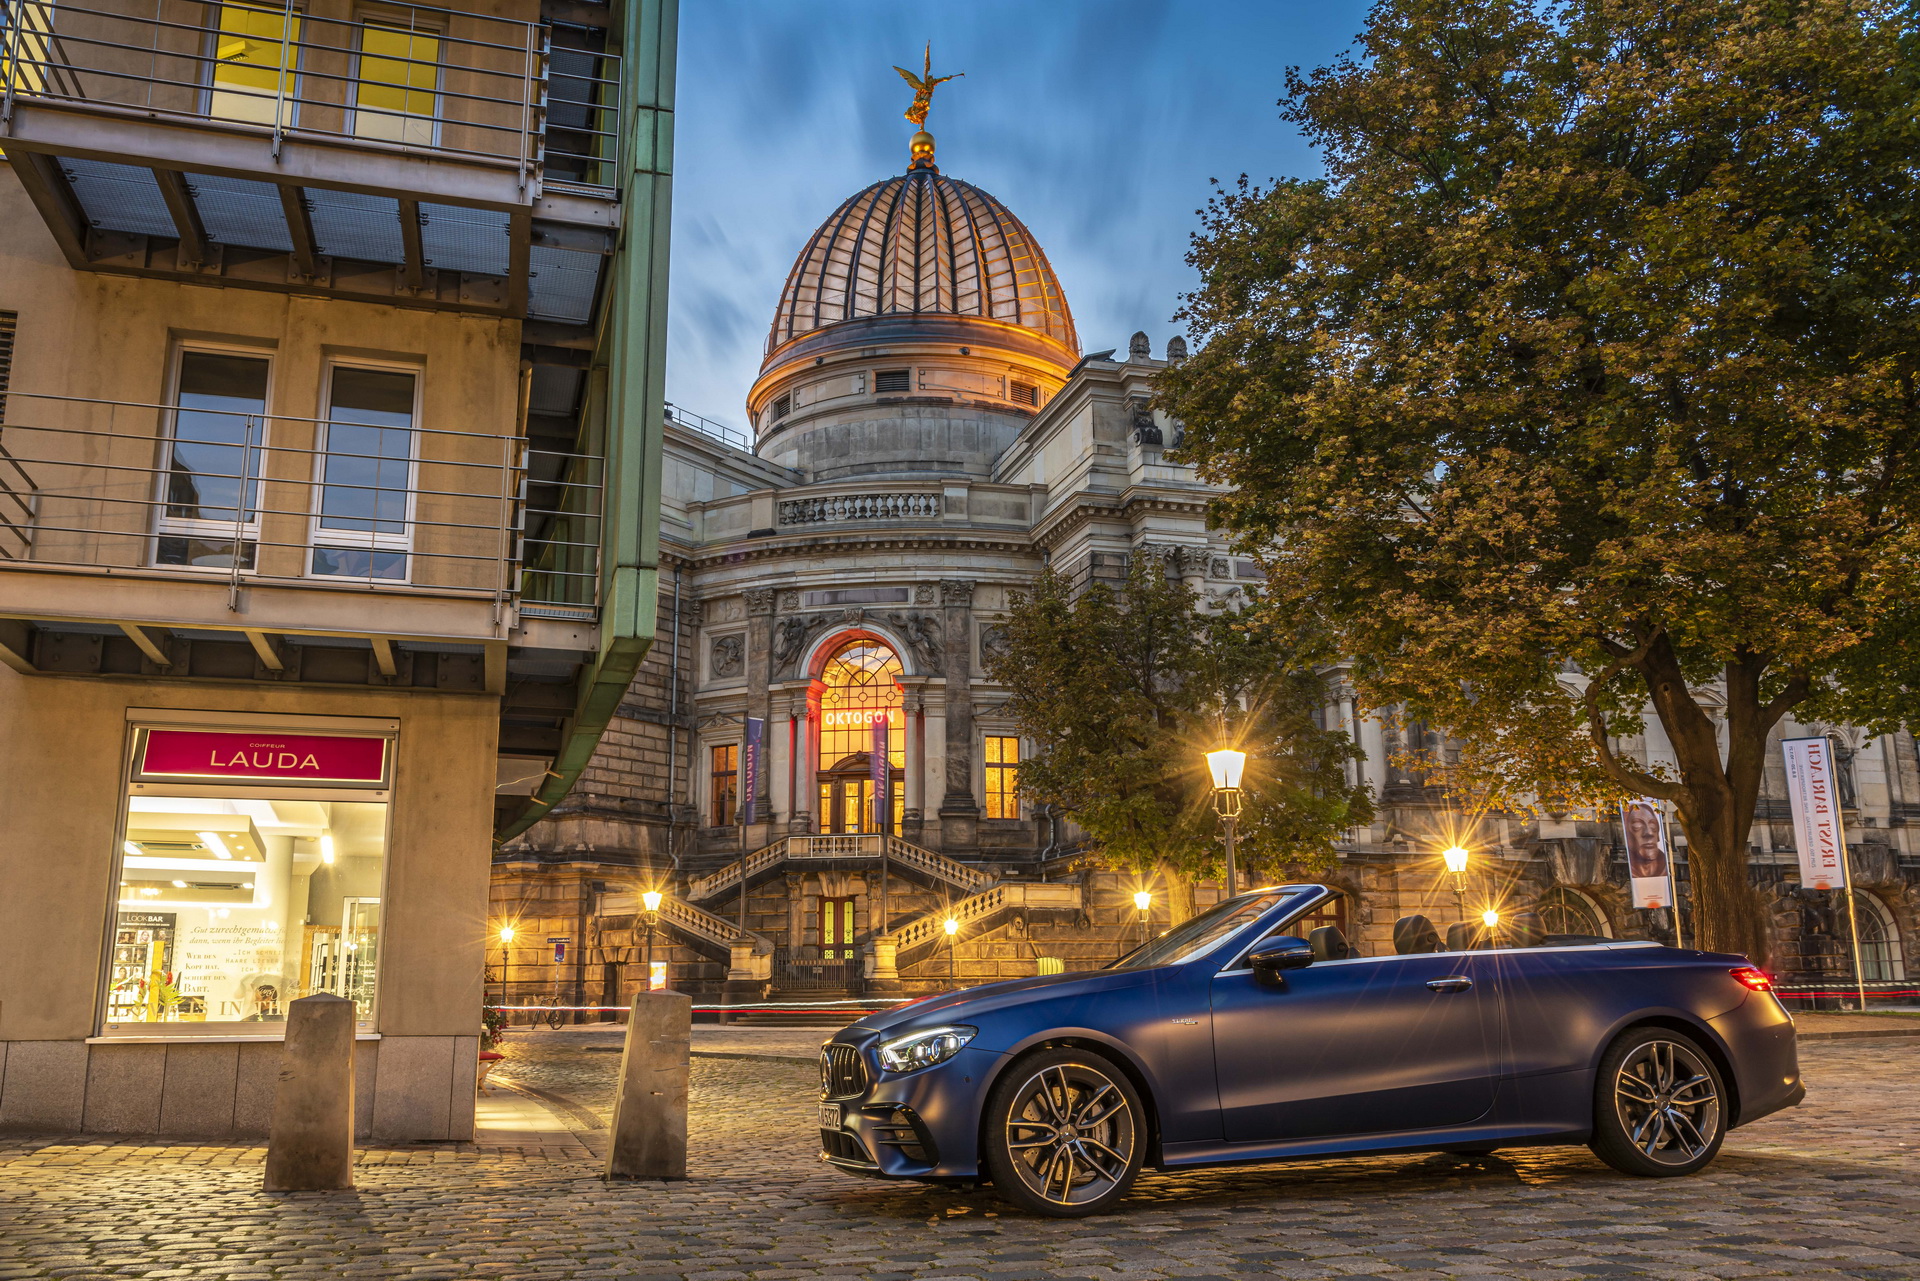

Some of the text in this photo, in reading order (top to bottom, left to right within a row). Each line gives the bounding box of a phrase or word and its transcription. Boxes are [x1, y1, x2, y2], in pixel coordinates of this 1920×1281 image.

[825, 711, 895, 725] OKTOGON
[210, 750, 320, 770] LAUDA
[219, 1001, 243, 1016] IN
